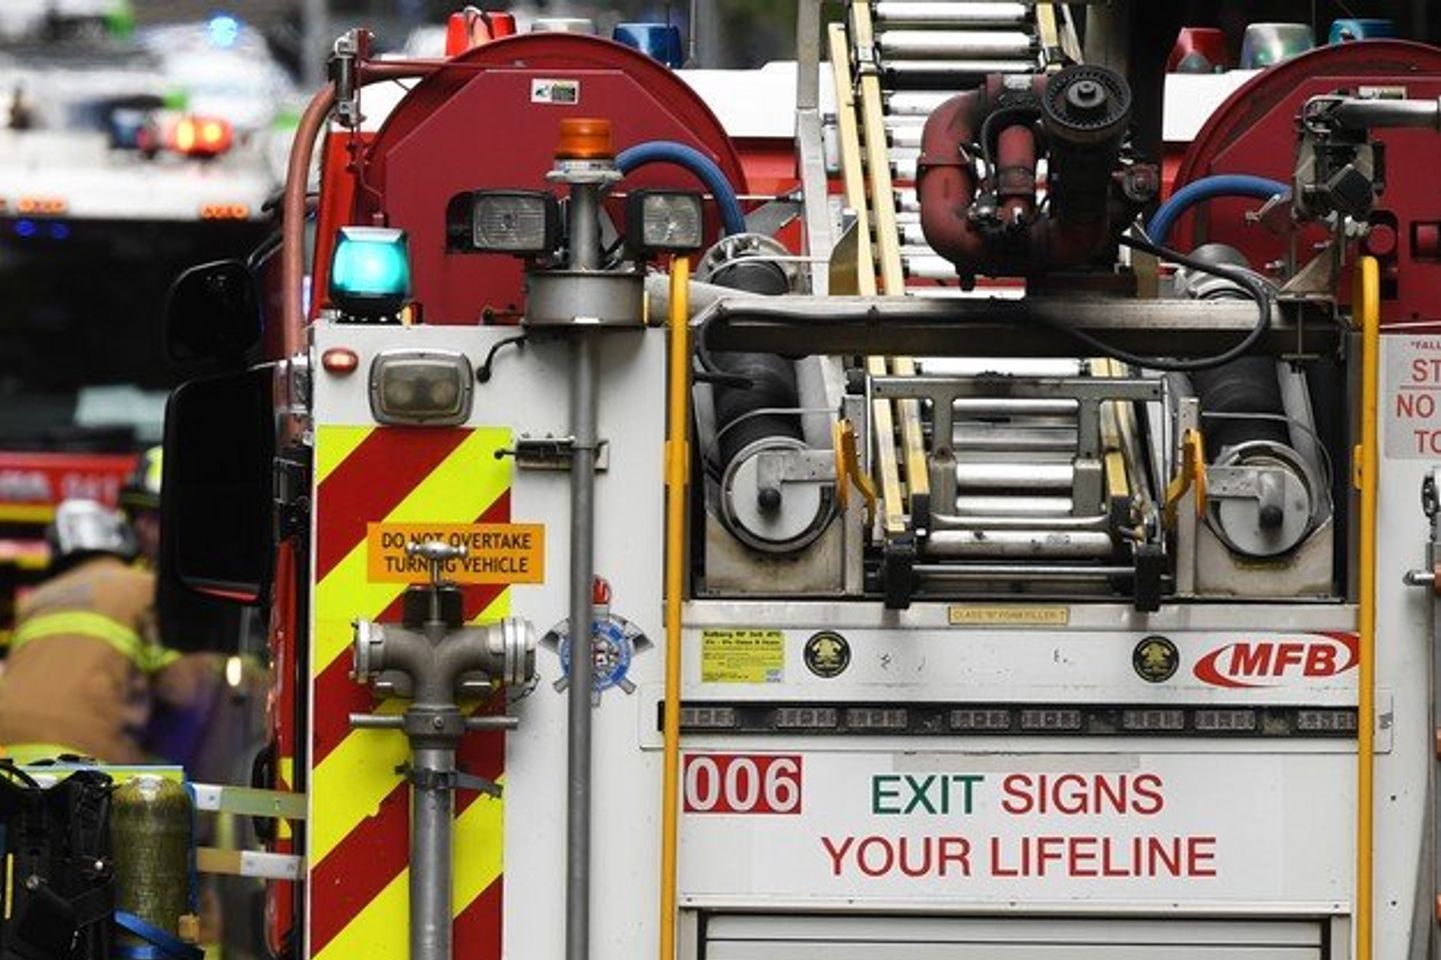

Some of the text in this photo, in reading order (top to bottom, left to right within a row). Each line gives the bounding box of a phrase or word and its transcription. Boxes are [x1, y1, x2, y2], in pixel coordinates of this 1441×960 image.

[1396, 393, 1435, 418] NO
[382, 532, 405, 549] DO
[450, 532, 532, 549] OVERTAKE
[463, 557, 528, 573] VEHICLE
[1229, 643, 1337, 676] MFB
[685, 756, 800, 811] 006
[872, 774, 1165, 815] EXIT SIGNS
[822, 836, 1216, 877] YOUR LIFELINE
